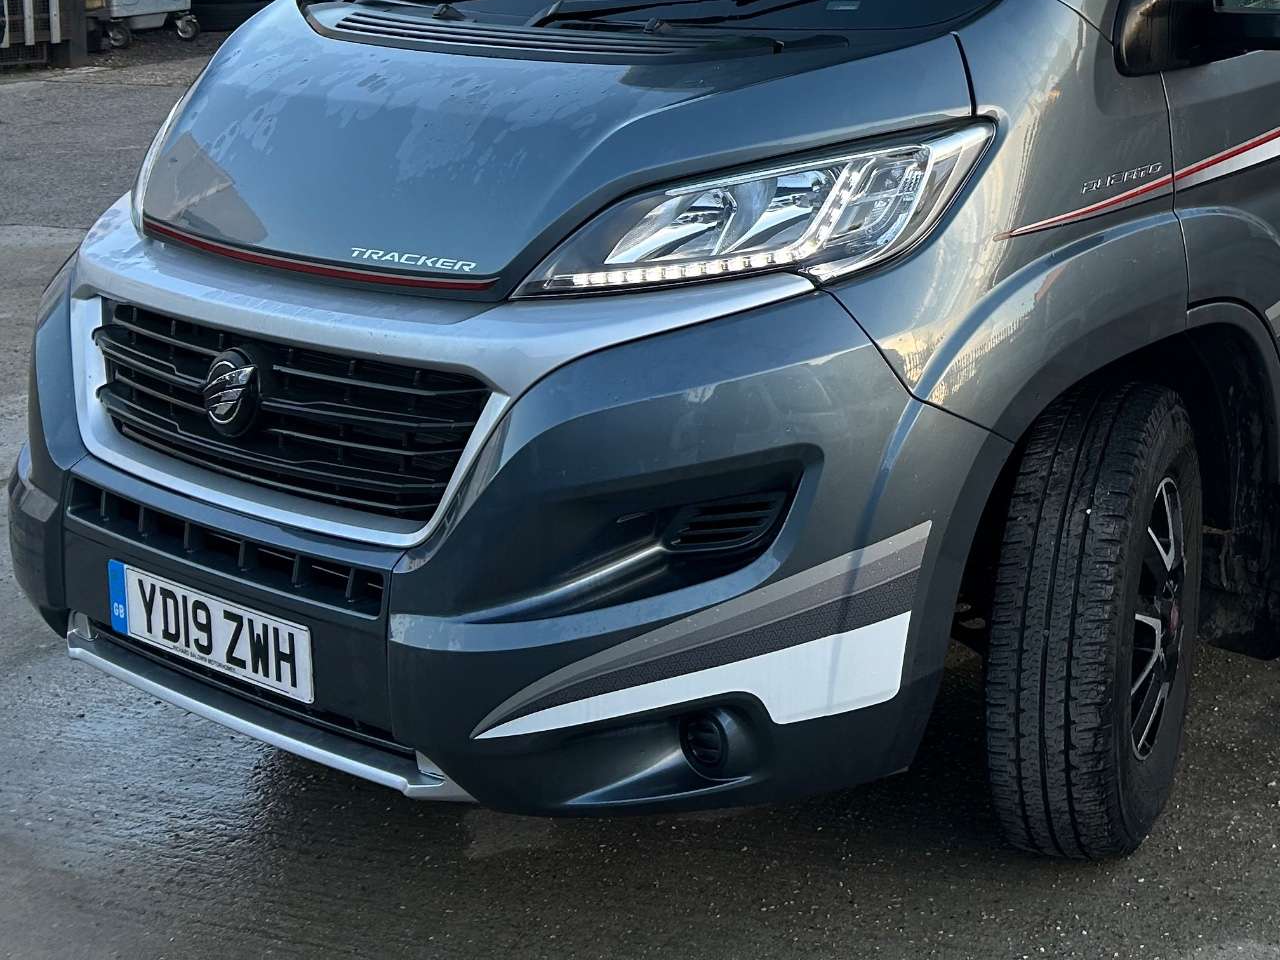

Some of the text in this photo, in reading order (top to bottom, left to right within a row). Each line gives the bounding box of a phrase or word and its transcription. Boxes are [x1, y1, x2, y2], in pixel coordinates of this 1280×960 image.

[351, 247, 477, 272] TRACKER
[113, 602, 125, 619] GB
[138, 578, 298, 689] YD19 ZWH
